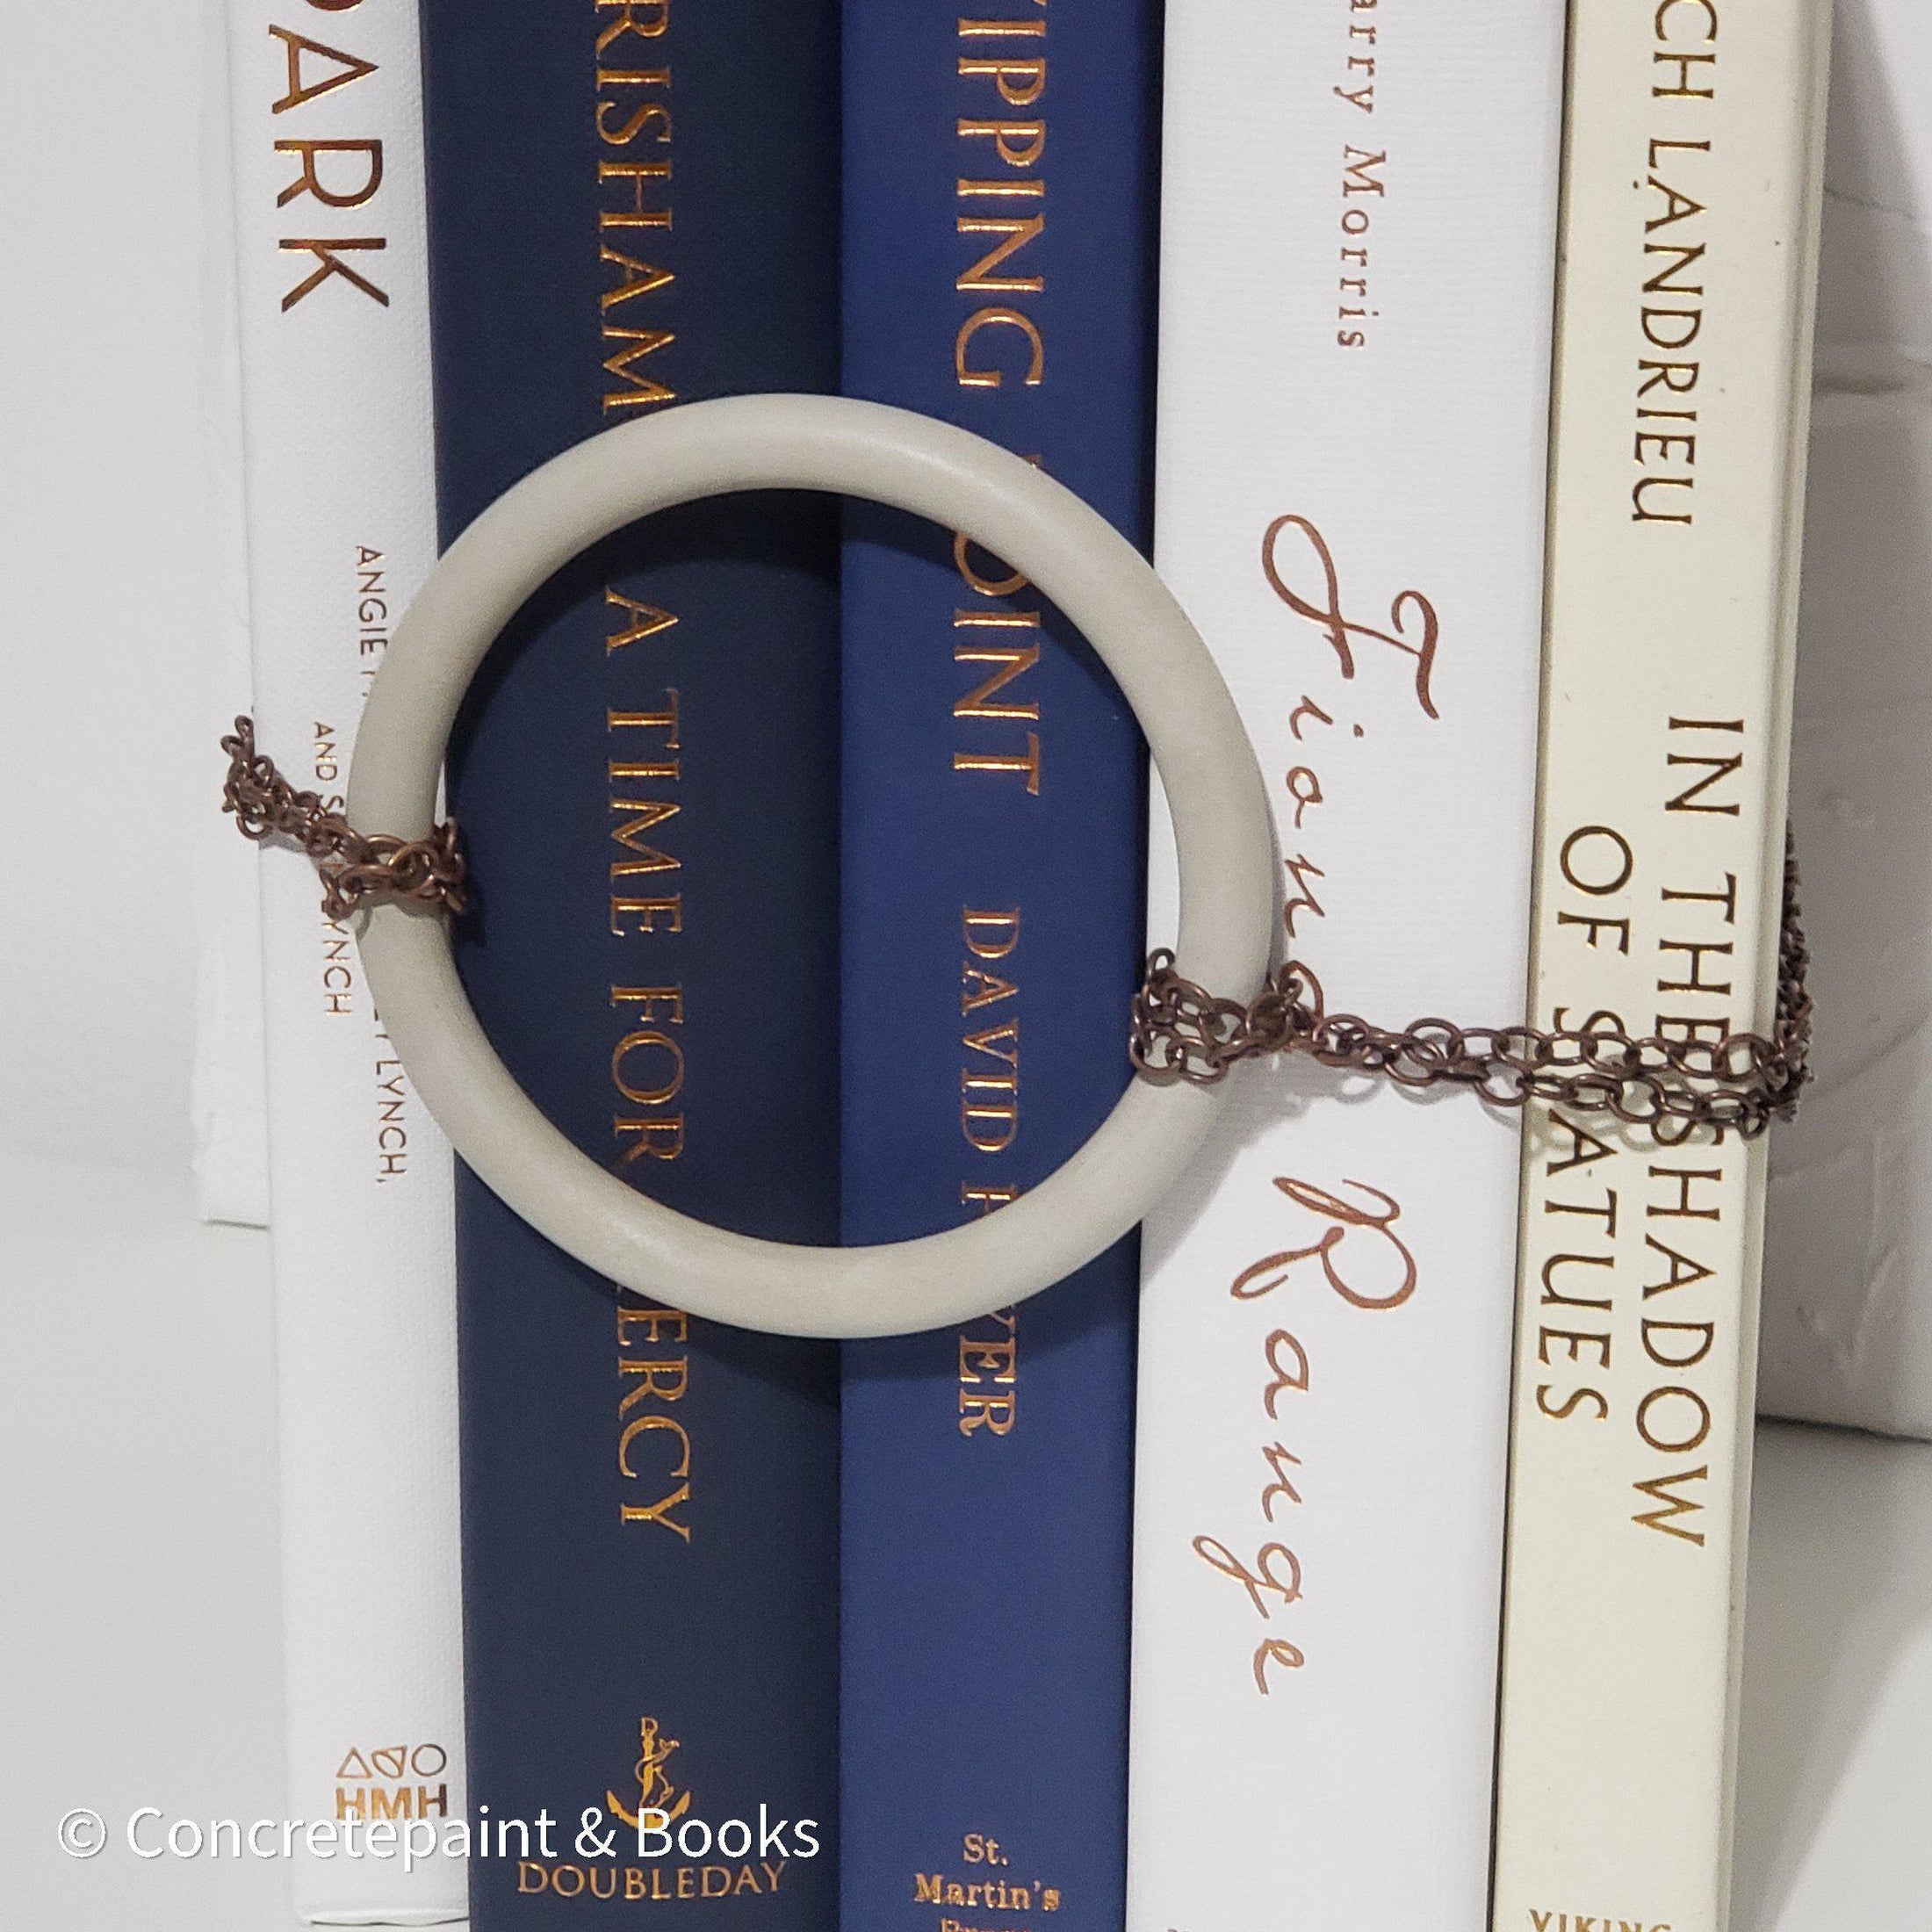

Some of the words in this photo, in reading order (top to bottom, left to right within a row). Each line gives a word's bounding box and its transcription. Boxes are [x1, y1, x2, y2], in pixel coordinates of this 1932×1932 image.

[268, 0, 390, 313] ARK
[595, 0, 677, 415] RISHAM
[955, 0, 1047, 388] IPPING
[1336, 143, 1387, 348] Morris
[1631, 138, 1712, 526] LANDRIEU
[355, 545, 388, 657] ANGIE
[605, 586, 680, 656] A
[953, 455, 1045, 796] INT
[313, 721, 338, 782] AND
[606, 688, 682, 936] TIME
[1664, 715, 1744, 817] IN
[321, 913, 353, 1014] YNCH
[1557, 825, 1633, 956] OF
[1654, 871, 1737, 1047] THE
[611, 980, 685, 1169] FOR
[962, 903, 1020, 1153] DAVID
[376, 1059, 407, 1184] LYNCH,
[1536, 1006, 1630, 1423] SATUES
[616, 1283, 692, 1544] ERCY
[1193, 1176, 1417, 1696] Range
[335, 1784, 448, 1820] HMH
[517, 1859, 788, 1900] DOUBLEDAY
[914, 1872, 1062, 1913] Martin's
[962, 1834, 1009, 1866] St.
